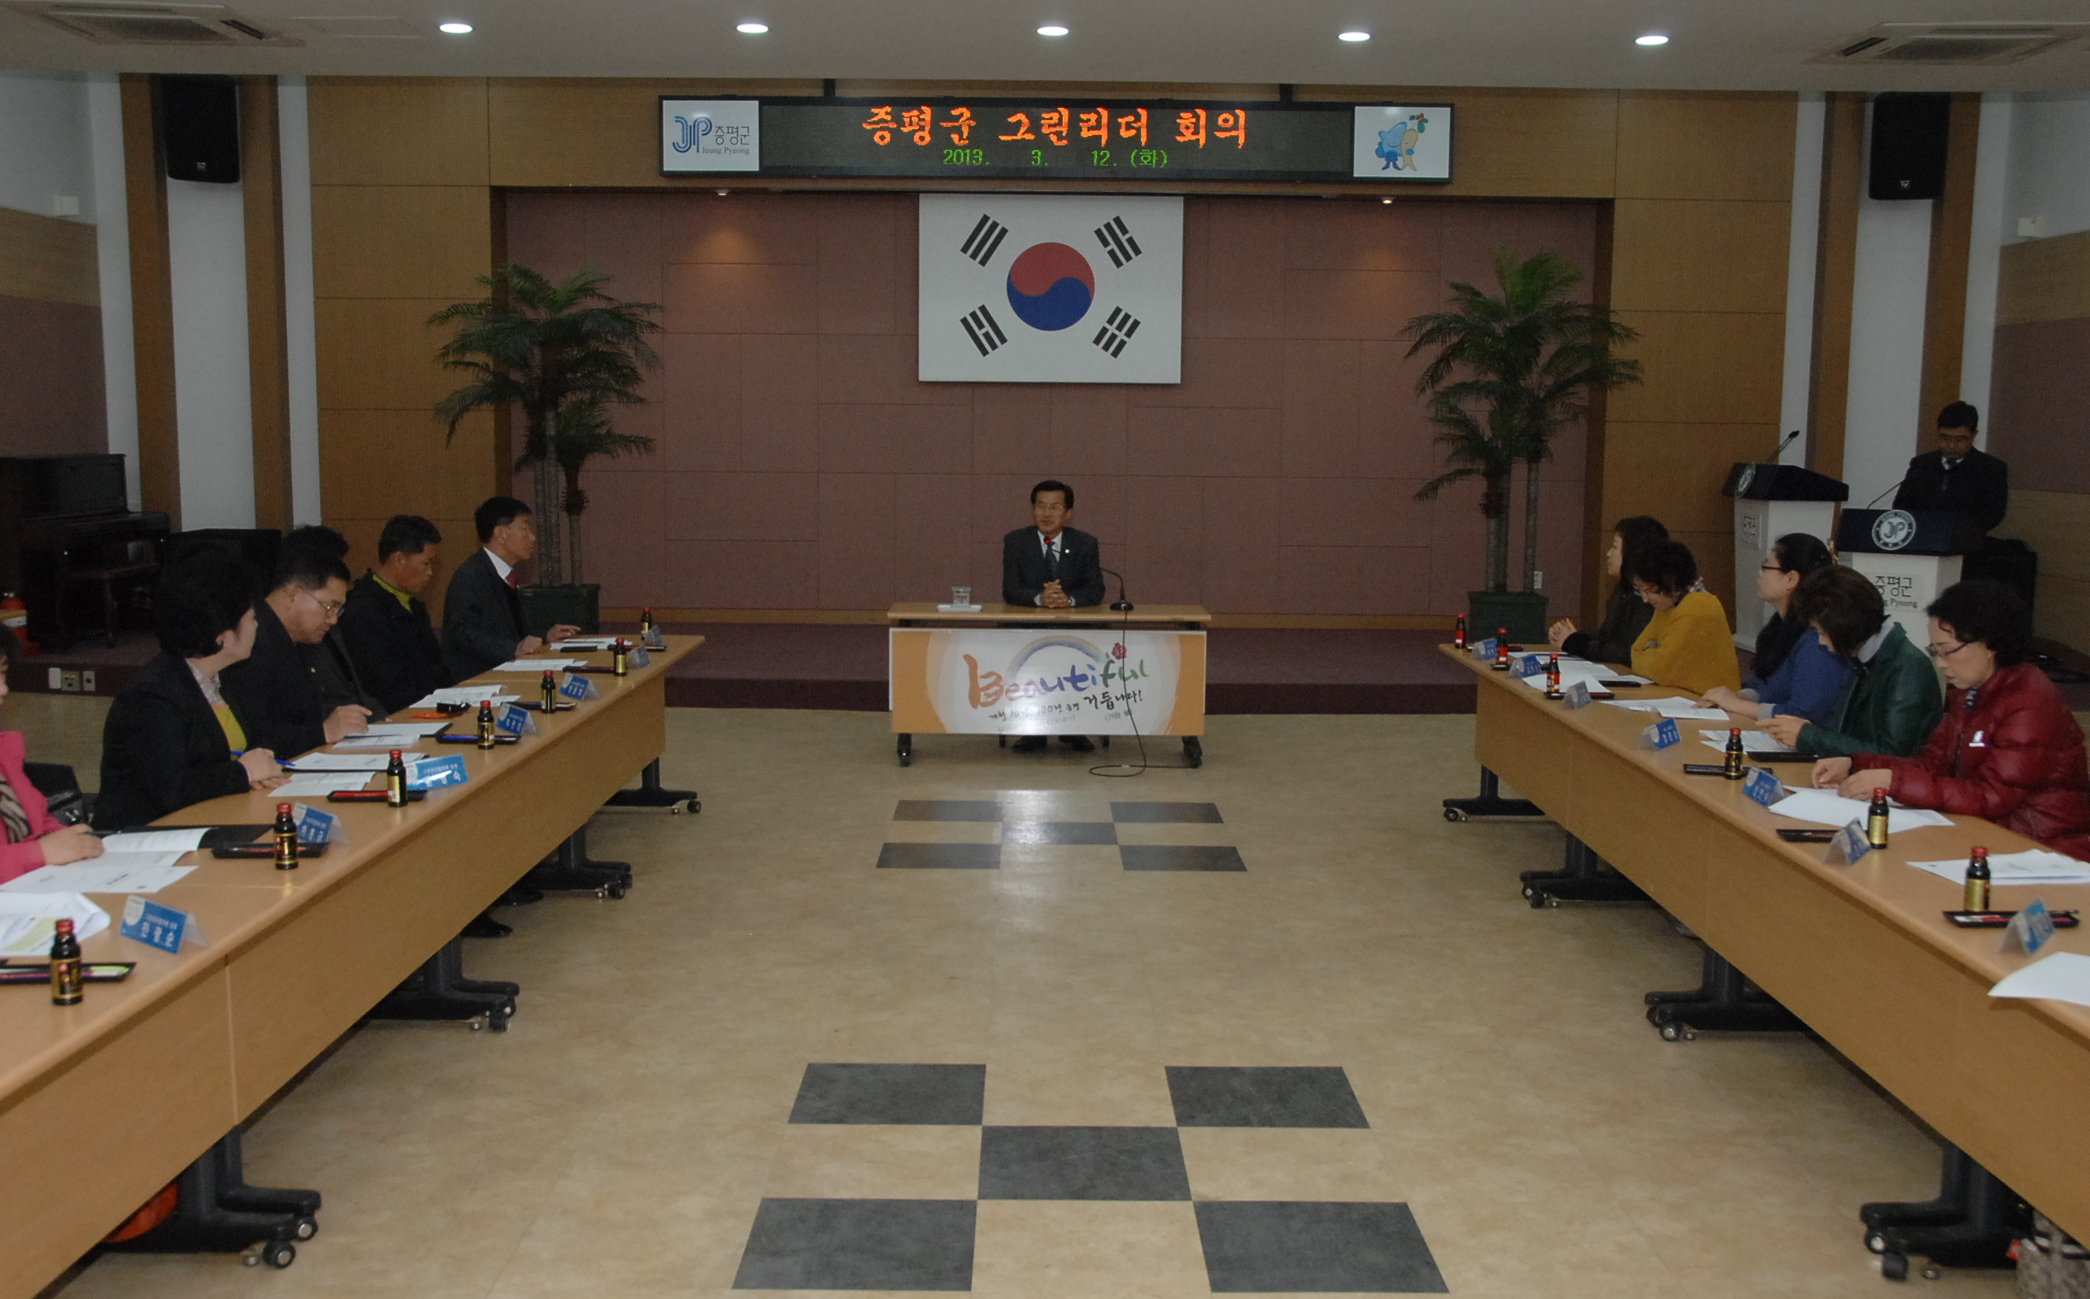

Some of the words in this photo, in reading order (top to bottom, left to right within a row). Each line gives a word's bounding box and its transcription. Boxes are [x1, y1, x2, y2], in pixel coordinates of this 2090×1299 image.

[715, 125, 750, 146] 증평군
[861, 105, 977, 146] 증평군
[998, 106, 1149, 147] 그린리더
[1175, 108, 1247, 149] 회의
[702, 147, 722, 155] Jeung
[724, 147, 750, 155] Pyeong
[943, 149, 990, 165] 2013.
[1031, 149, 1049, 166] 3.
[1091, 150, 1117, 167] 12.
[1130, 149, 1169, 168] (화)
[1875, 575, 1912, 598] 증평군
[962, 652, 1150, 711] Beautiful
